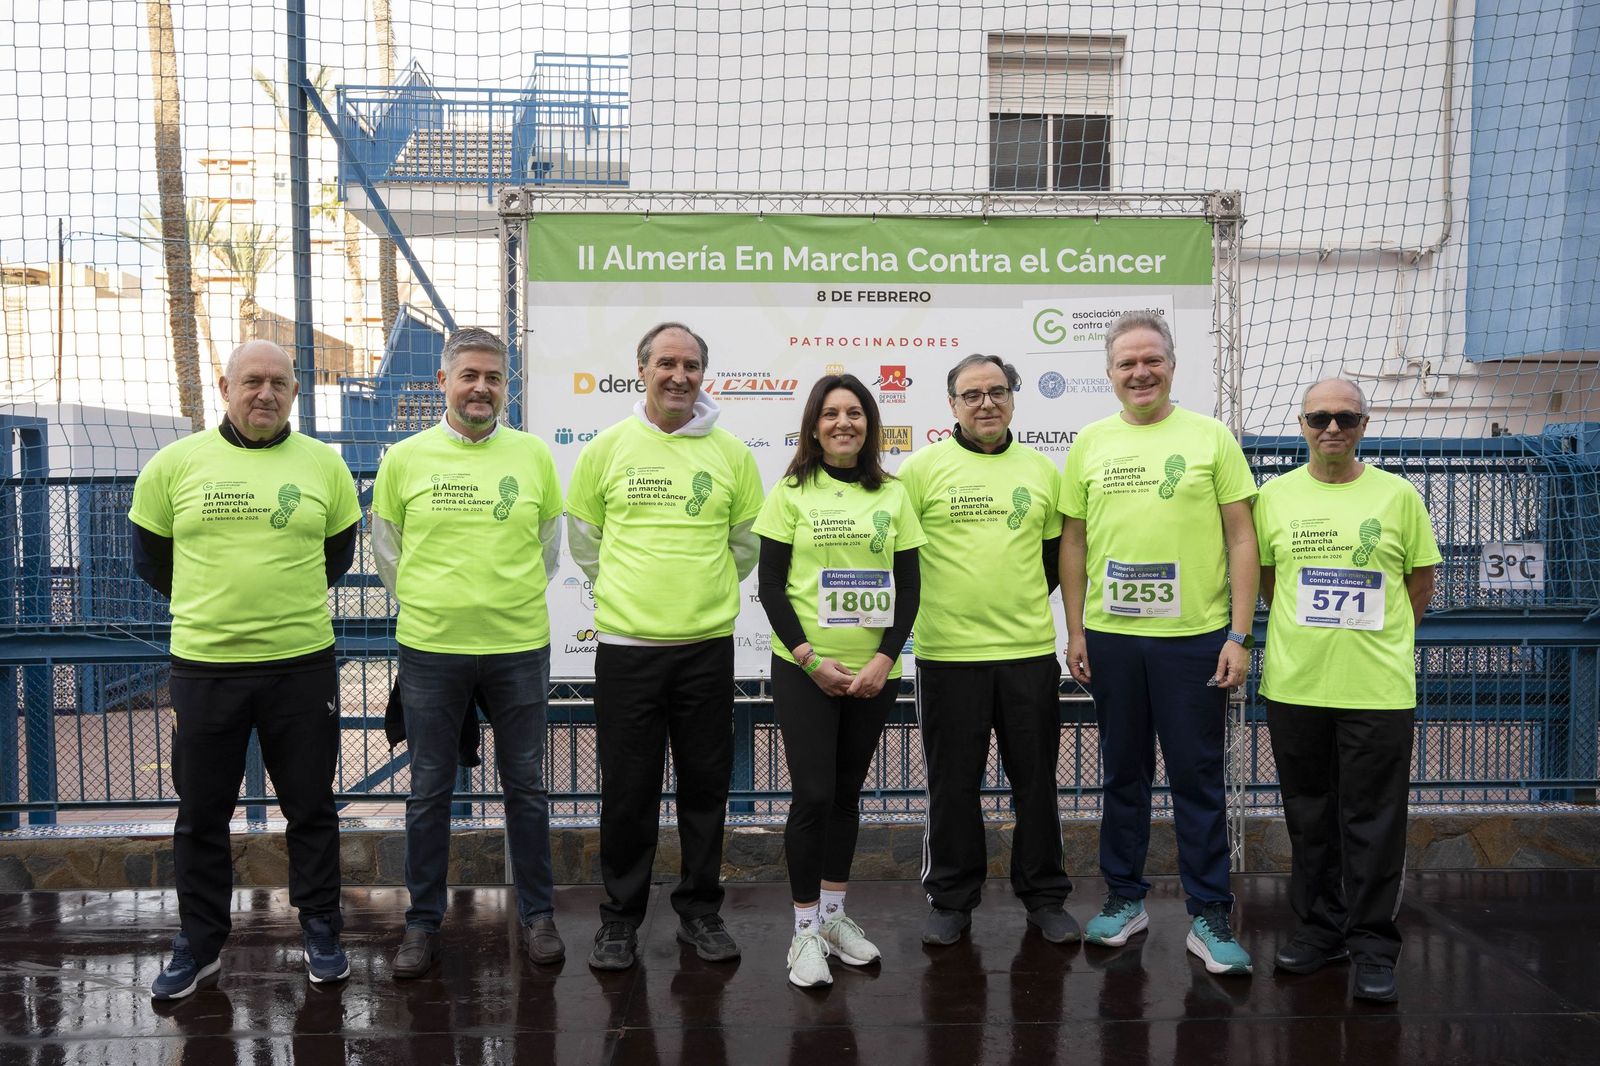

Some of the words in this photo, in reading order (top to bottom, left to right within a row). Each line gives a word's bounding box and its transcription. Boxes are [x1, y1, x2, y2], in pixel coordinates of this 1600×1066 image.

[578, 245, 594, 271] II
[603, 245, 726, 271] Almería
[736, 246, 773, 271] En
[784, 246, 898, 272] Marcha
[907, 248, 1012, 273] Contra
[1020, 248, 1049, 273] el
[1057, 248, 1167, 274] Cáncer
[817, 290, 826, 302] 8
[832, 290, 852, 302] DE
[858, 291, 931, 303] FEBRERO
[1072, 311, 1121, 319] asociación
[1073, 321, 1102, 330] contra
[1111, 466, 1146, 475] Almería
[441, 483, 479, 491] Almería
[213, 492, 255, 500] Almería
[820, 518, 855, 526] Almería
[1300, 529, 1338, 538] Almería
[1108, 581, 1174, 602] 1253
[825, 591, 891, 612] 1800
[1312, 589, 1365, 613] 571
